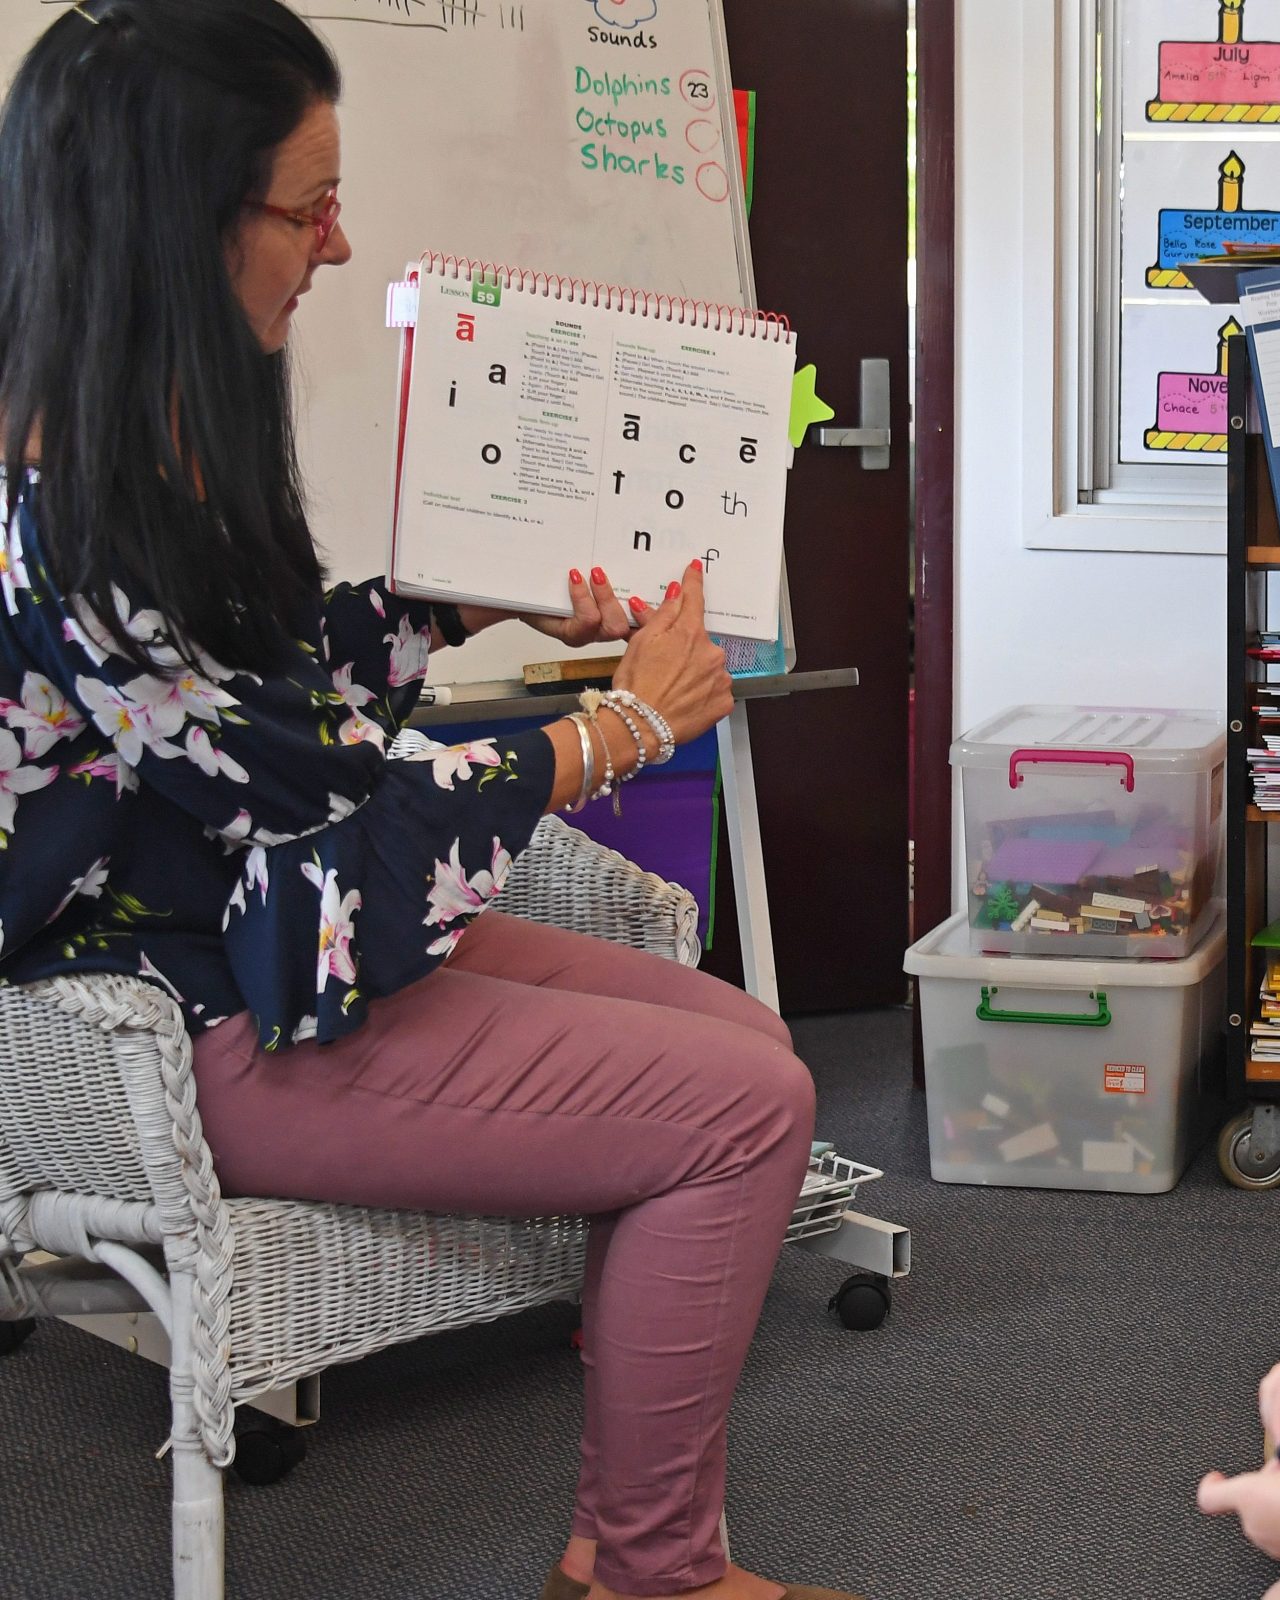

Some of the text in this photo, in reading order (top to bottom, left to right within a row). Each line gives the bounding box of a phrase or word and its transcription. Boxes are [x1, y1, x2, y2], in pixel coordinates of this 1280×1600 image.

[589, 27, 657, 49] Sounds
[1214, 47, 1249, 64] July
[576, 66, 709, 105] Dolphins 23
[1164, 71, 1199, 81] Amelia
[576, 108, 667, 142] Octopus
[581, 144, 685, 184] Sharks
[1184, 215, 1278, 231] September
[477, 291, 495, 304] 59
[551, 328, 580, 338] EXERCISE
[556, 321, 582, 330] SOUNDS
[488, 364, 507, 385] a
[448, 380, 457, 408] i
[1164, 403, 1199, 414] Chace
[480, 442, 502, 465] o
[679, 444, 696, 464] c
[612, 469, 625, 495] t
[491, 494, 521, 504] EXERCISE
[665, 489, 684, 510] o
[720, 490, 747, 517] th
[633, 529, 652, 551] n
[701, 548, 720, 574] f
